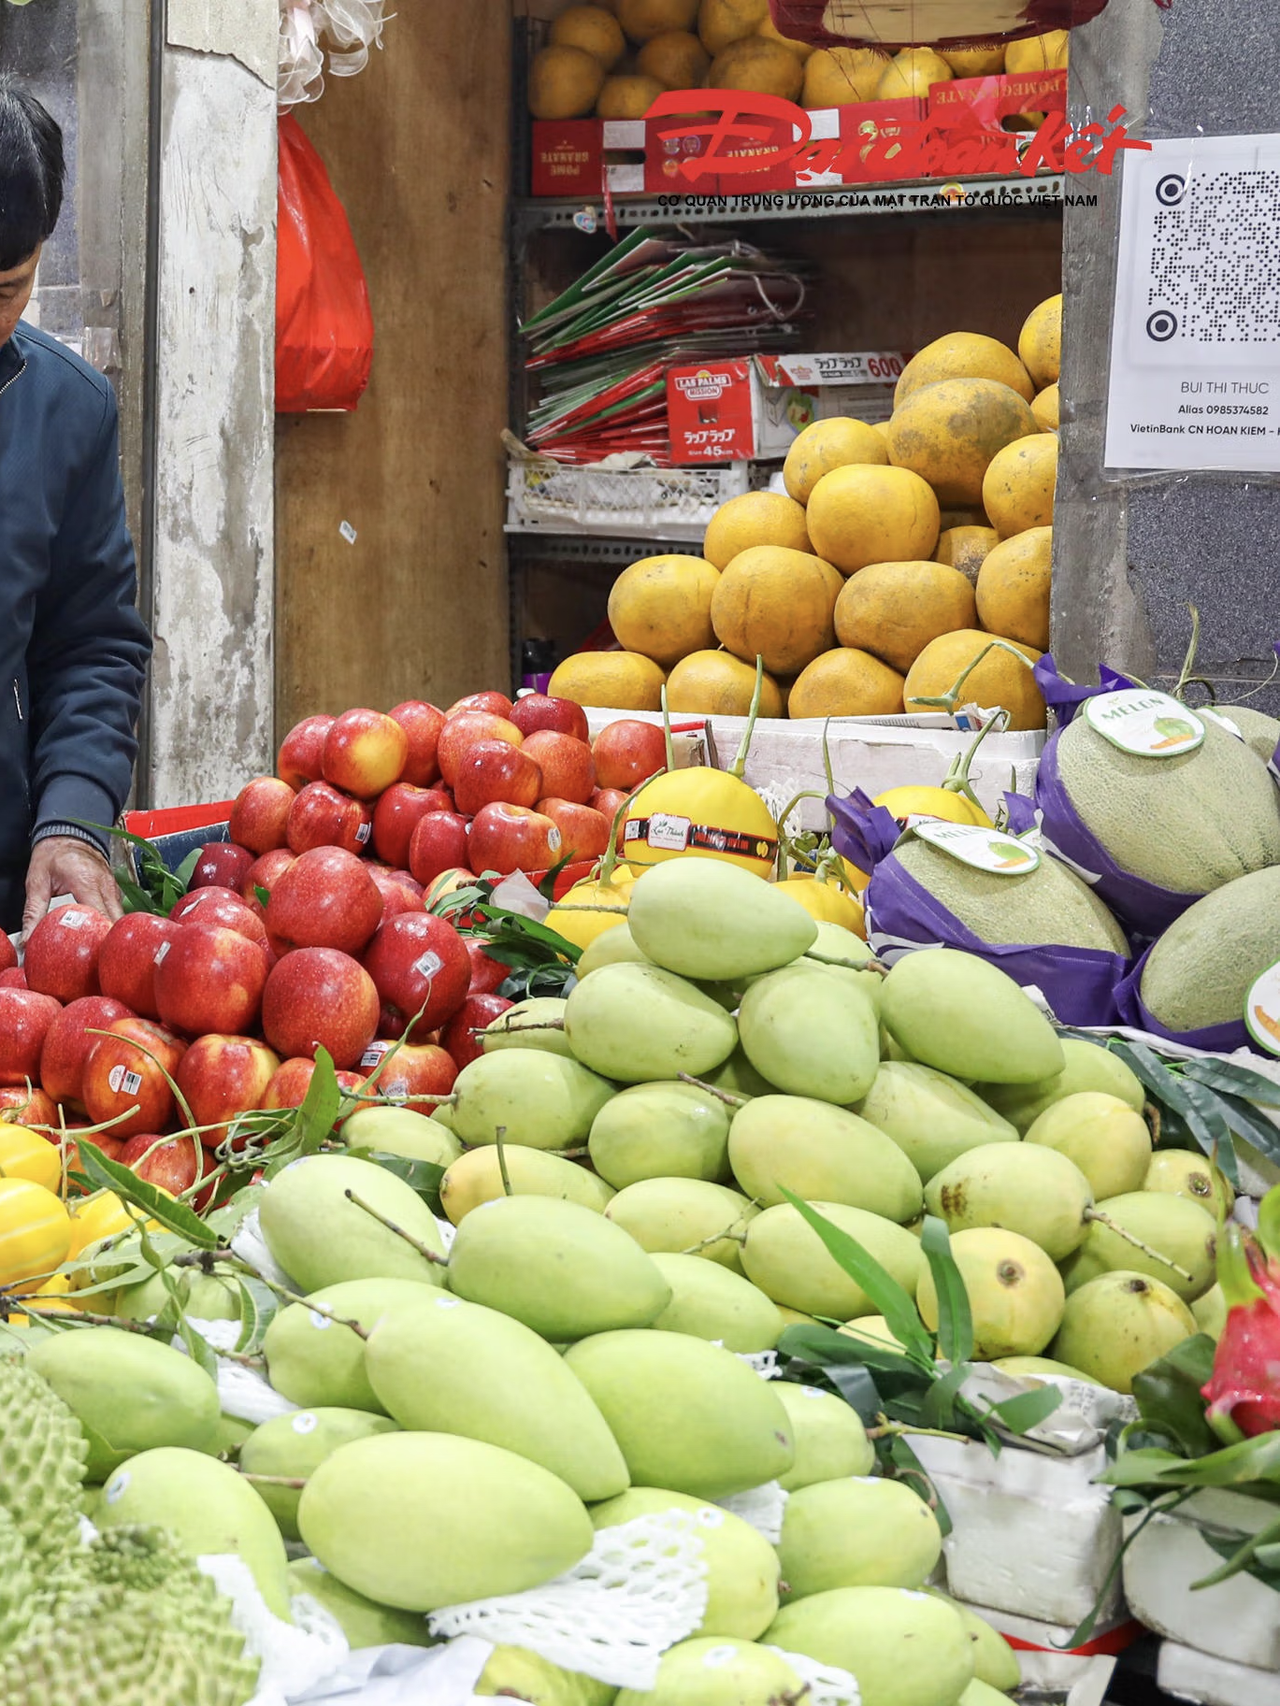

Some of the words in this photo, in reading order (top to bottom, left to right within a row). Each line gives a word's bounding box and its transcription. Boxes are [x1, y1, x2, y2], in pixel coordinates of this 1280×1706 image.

[867, 357, 902, 378] 600
[680, 379, 696, 388] LAS
[698, 376, 727, 386] PALMS
[1181, 381, 1203, 394] BUI
[1206, 382, 1227, 394] THI
[1231, 382, 1269, 394] THUC
[690, 387, 718, 395] MISSION
[1178, 405, 1204, 414] Alias
[1206, 405, 1269, 415] 0985374582
[1130, 423, 1185, 434] VietinBank
[1188, 425, 1204, 434] CN
[1206, 425, 1238, 435] HOAN
[1240, 426, 1266, 436] KIEM
[1100, 698, 1166, 720] MELON
